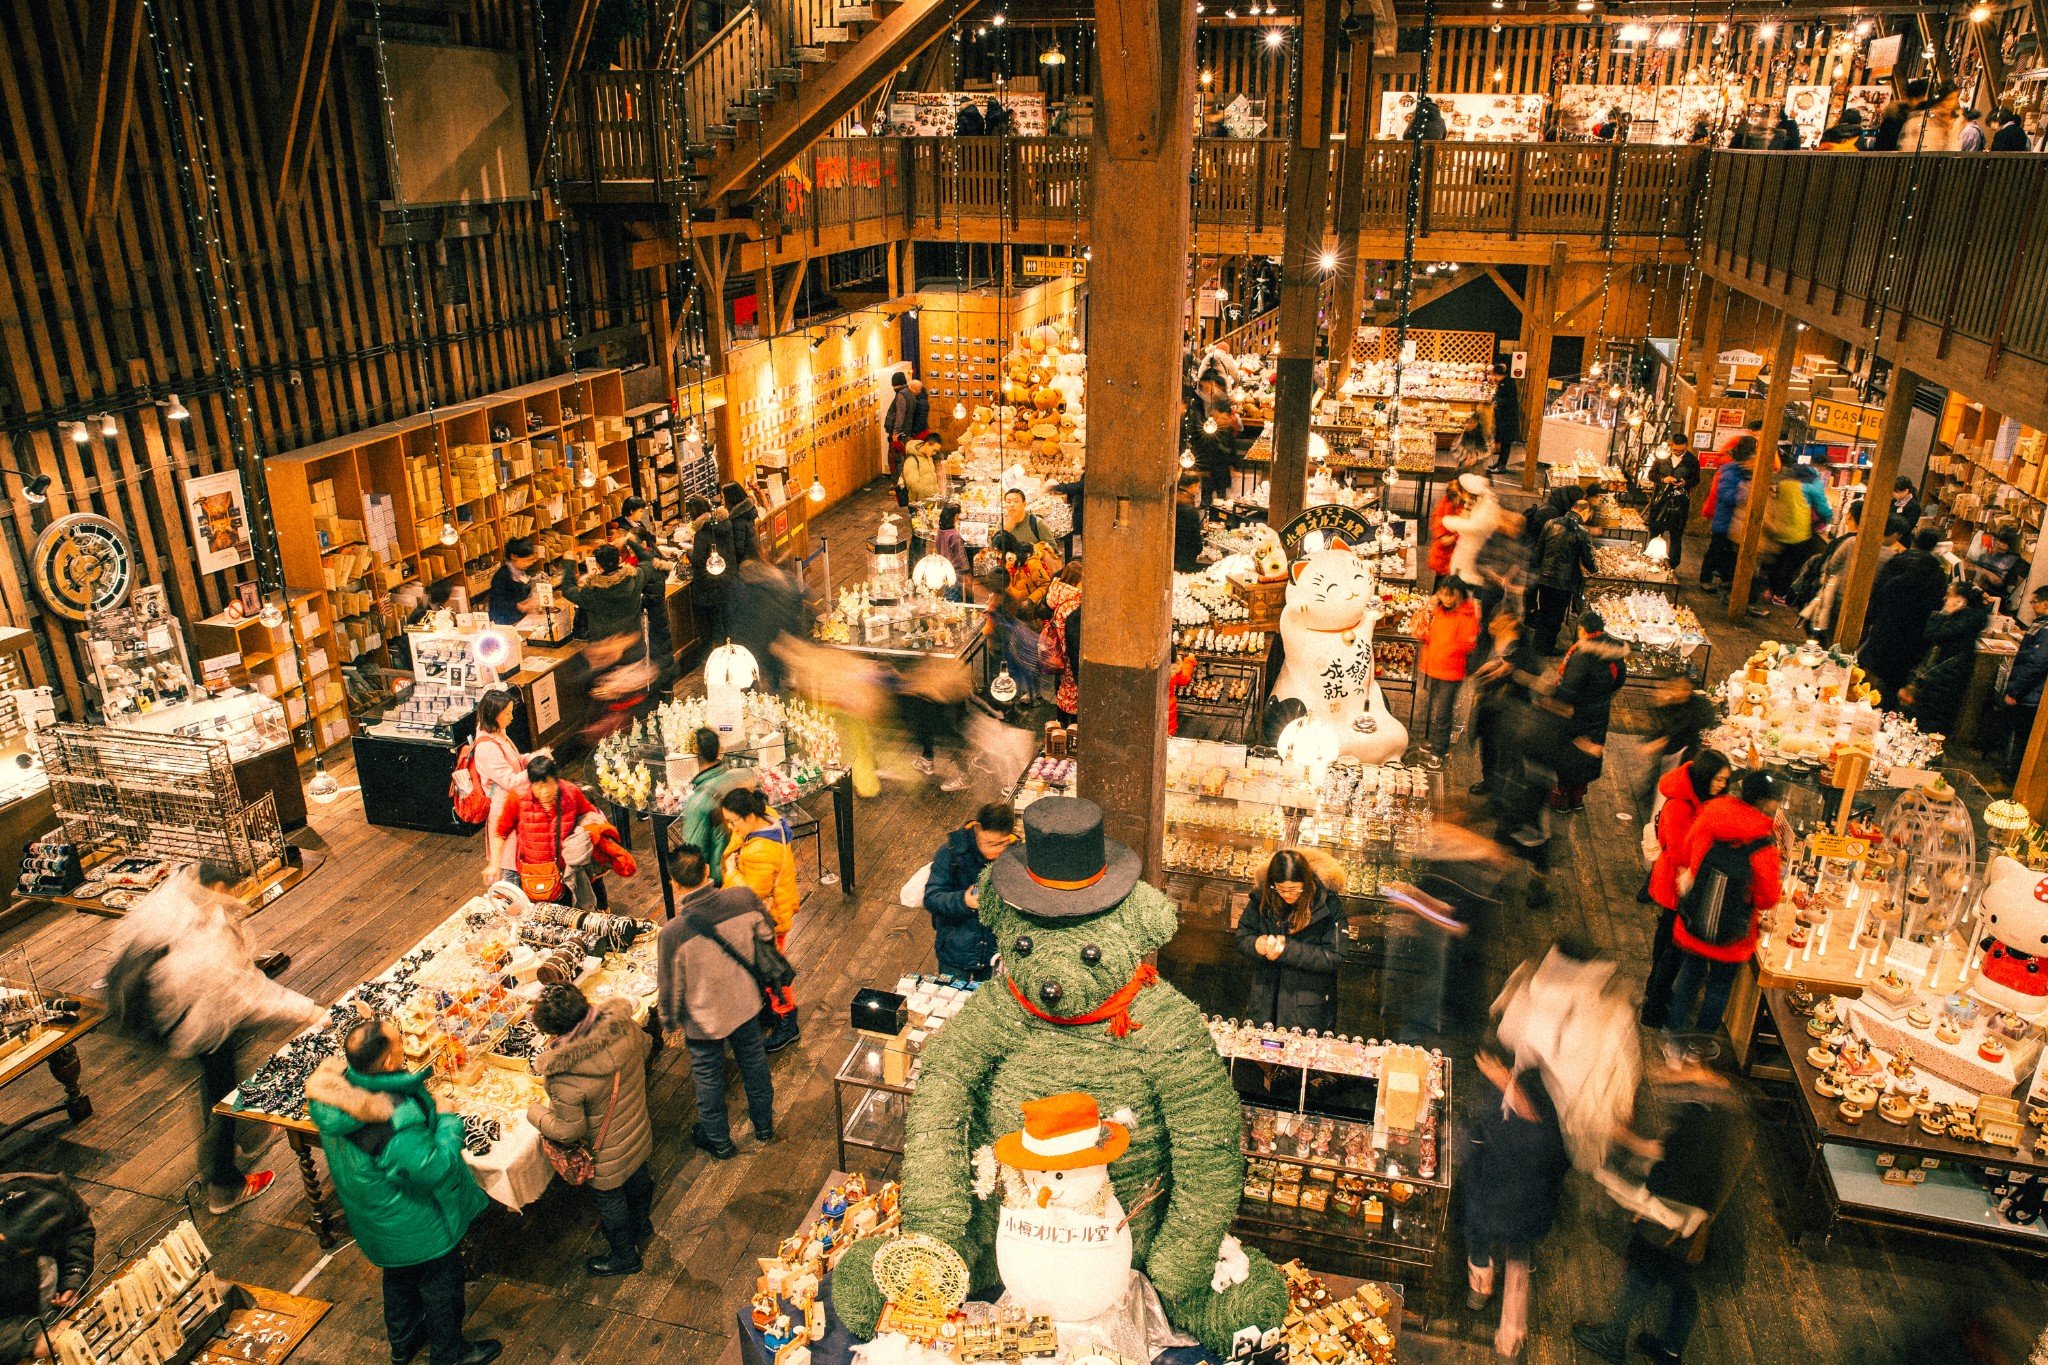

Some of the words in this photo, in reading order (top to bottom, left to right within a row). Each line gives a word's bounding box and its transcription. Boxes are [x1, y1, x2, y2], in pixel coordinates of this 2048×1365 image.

[1040, 260, 1071, 269] TOILET
[1286, 514, 1365, 546] 小樽オルゴール堂
[542, 594, 550, 605] 3
[1006, 1216, 1110, 1243] 小樽オルゴール堂
